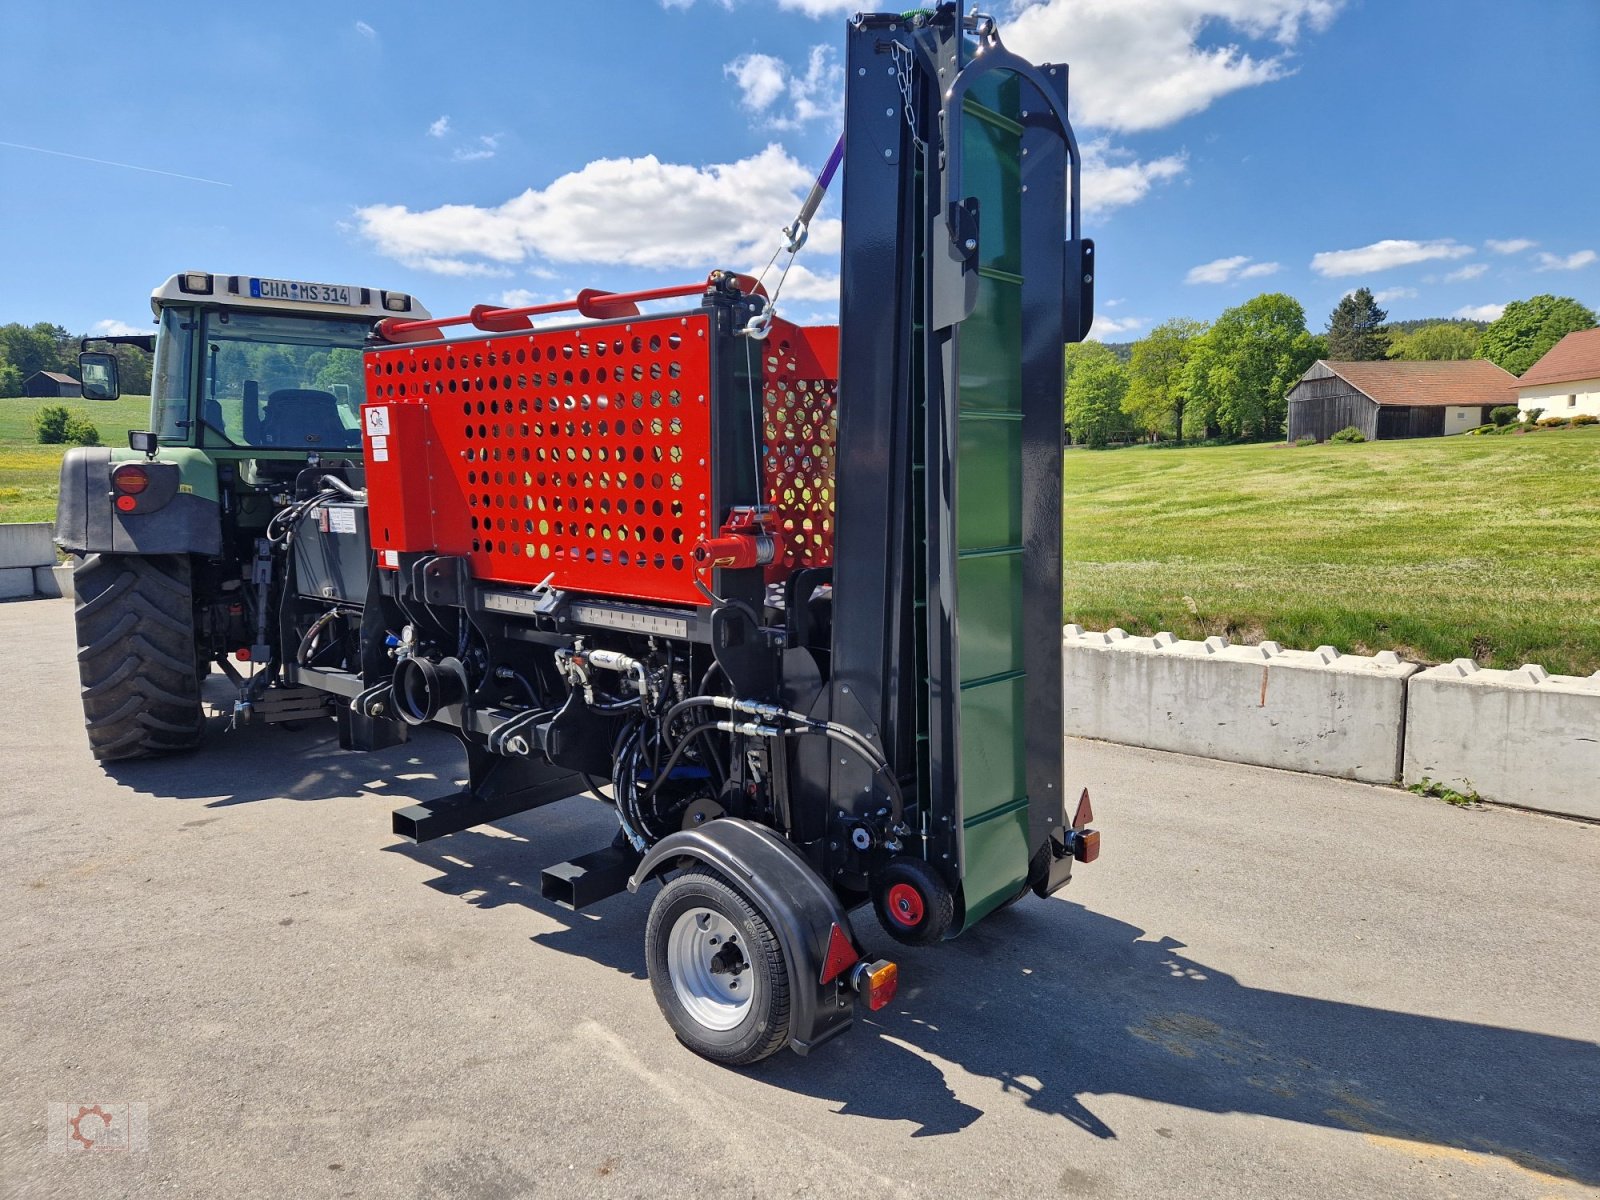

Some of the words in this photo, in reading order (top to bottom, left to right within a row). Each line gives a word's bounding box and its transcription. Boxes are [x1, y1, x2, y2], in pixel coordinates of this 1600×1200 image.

[261, 281, 288, 298] CHA
[300, 285, 318, 302] MS
[322, 287, 348, 302] 314
